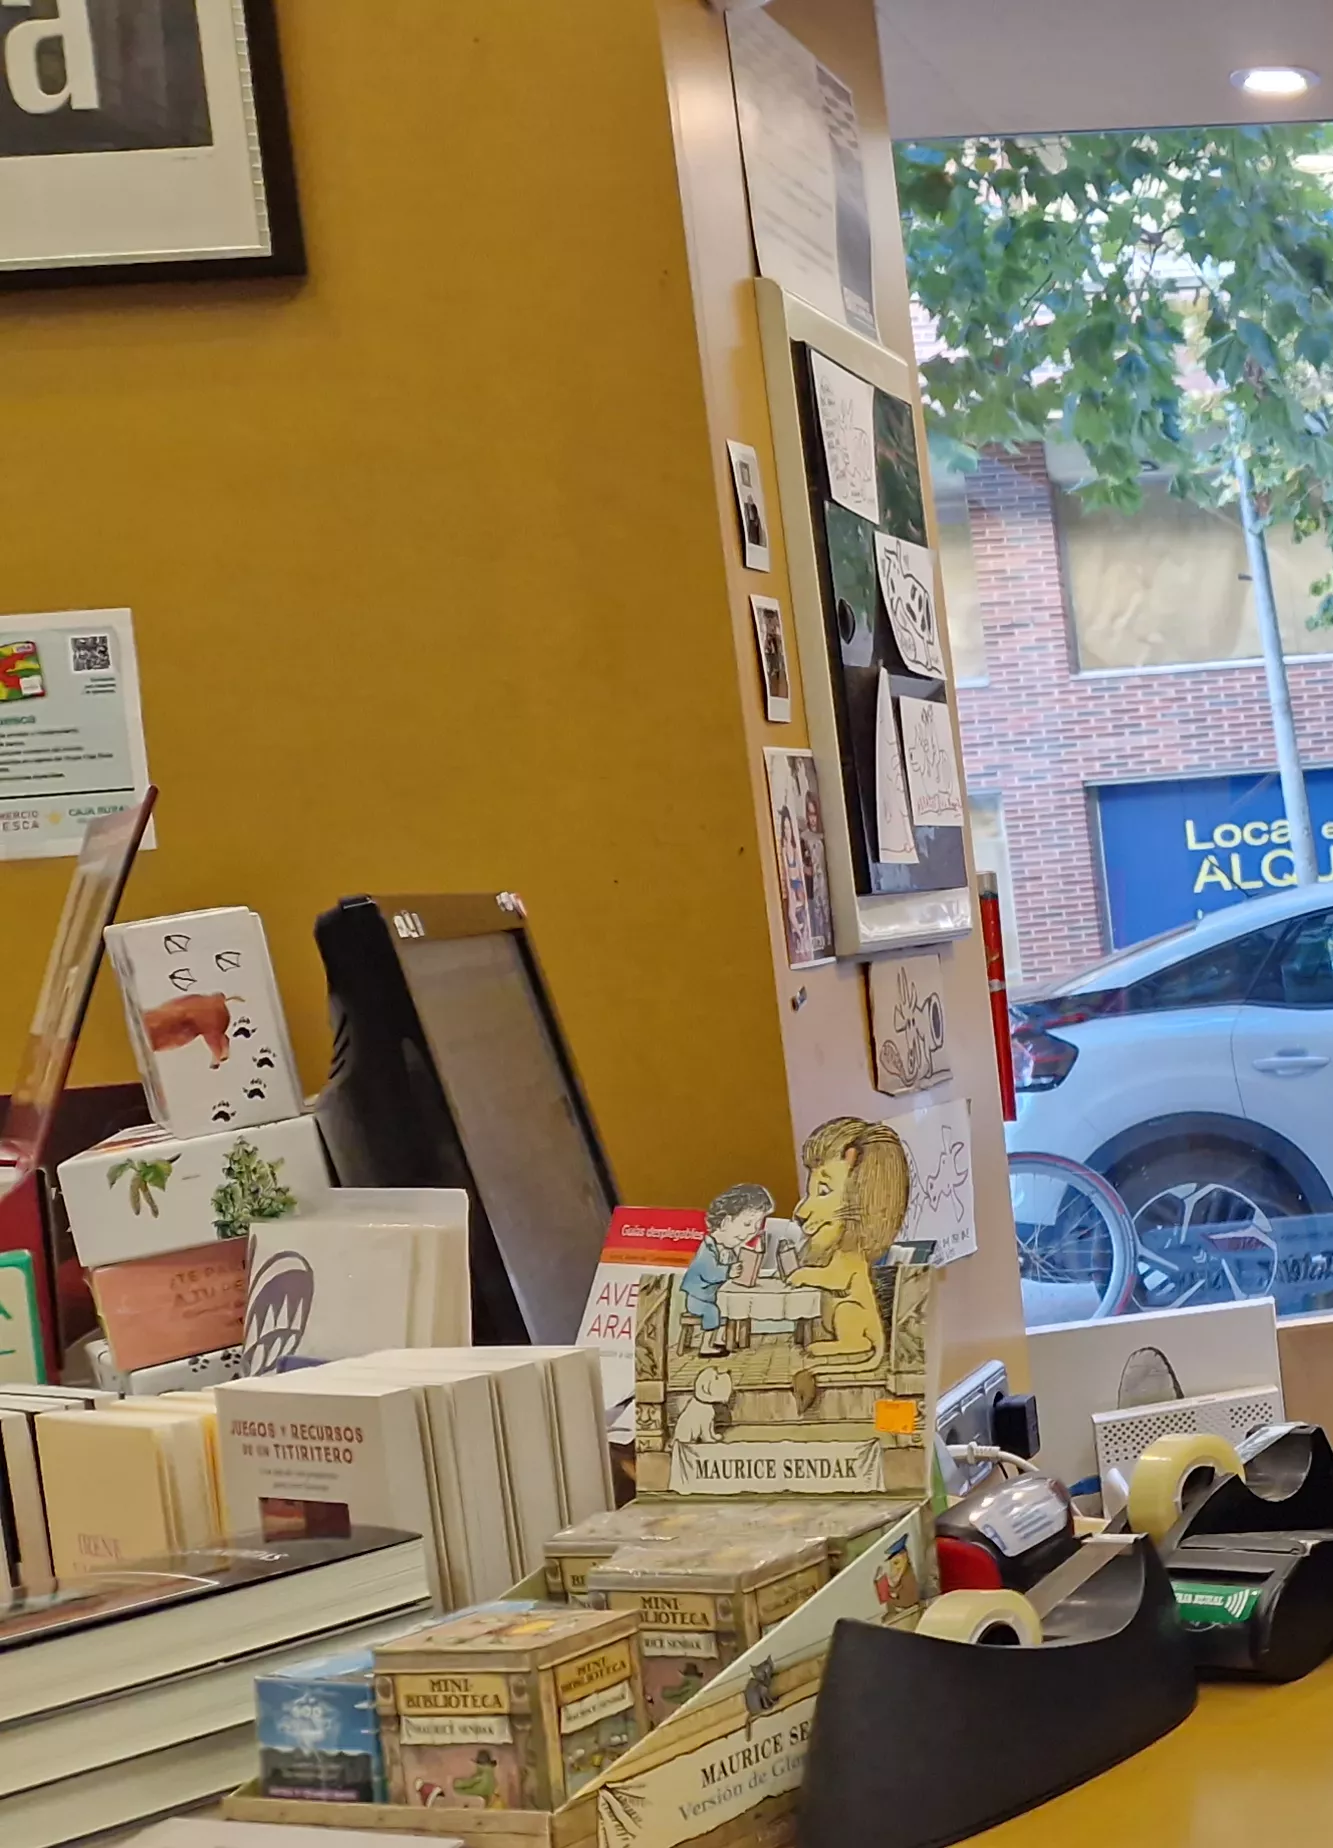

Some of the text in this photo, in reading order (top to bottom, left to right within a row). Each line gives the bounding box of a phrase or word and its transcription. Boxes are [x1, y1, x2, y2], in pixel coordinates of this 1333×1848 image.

[1185, 818, 1293, 851] Loca
[596, 1282, 640, 1308] AVE
[231, 1420, 276, 1439] JUEGOS
[290, 1423, 365, 1444] RECURSOS
[272, 1443, 354, 1464] TITIRITERO
[695, 1458, 860, 1480] MAURICE SENDAK
[404, 1693, 503, 1709] BIBLIOTECA
[700, 1732, 783, 1789] MAURICE
[678, 1780, 744, 1821] Versión
[748, 1771, 768, 1789] de
